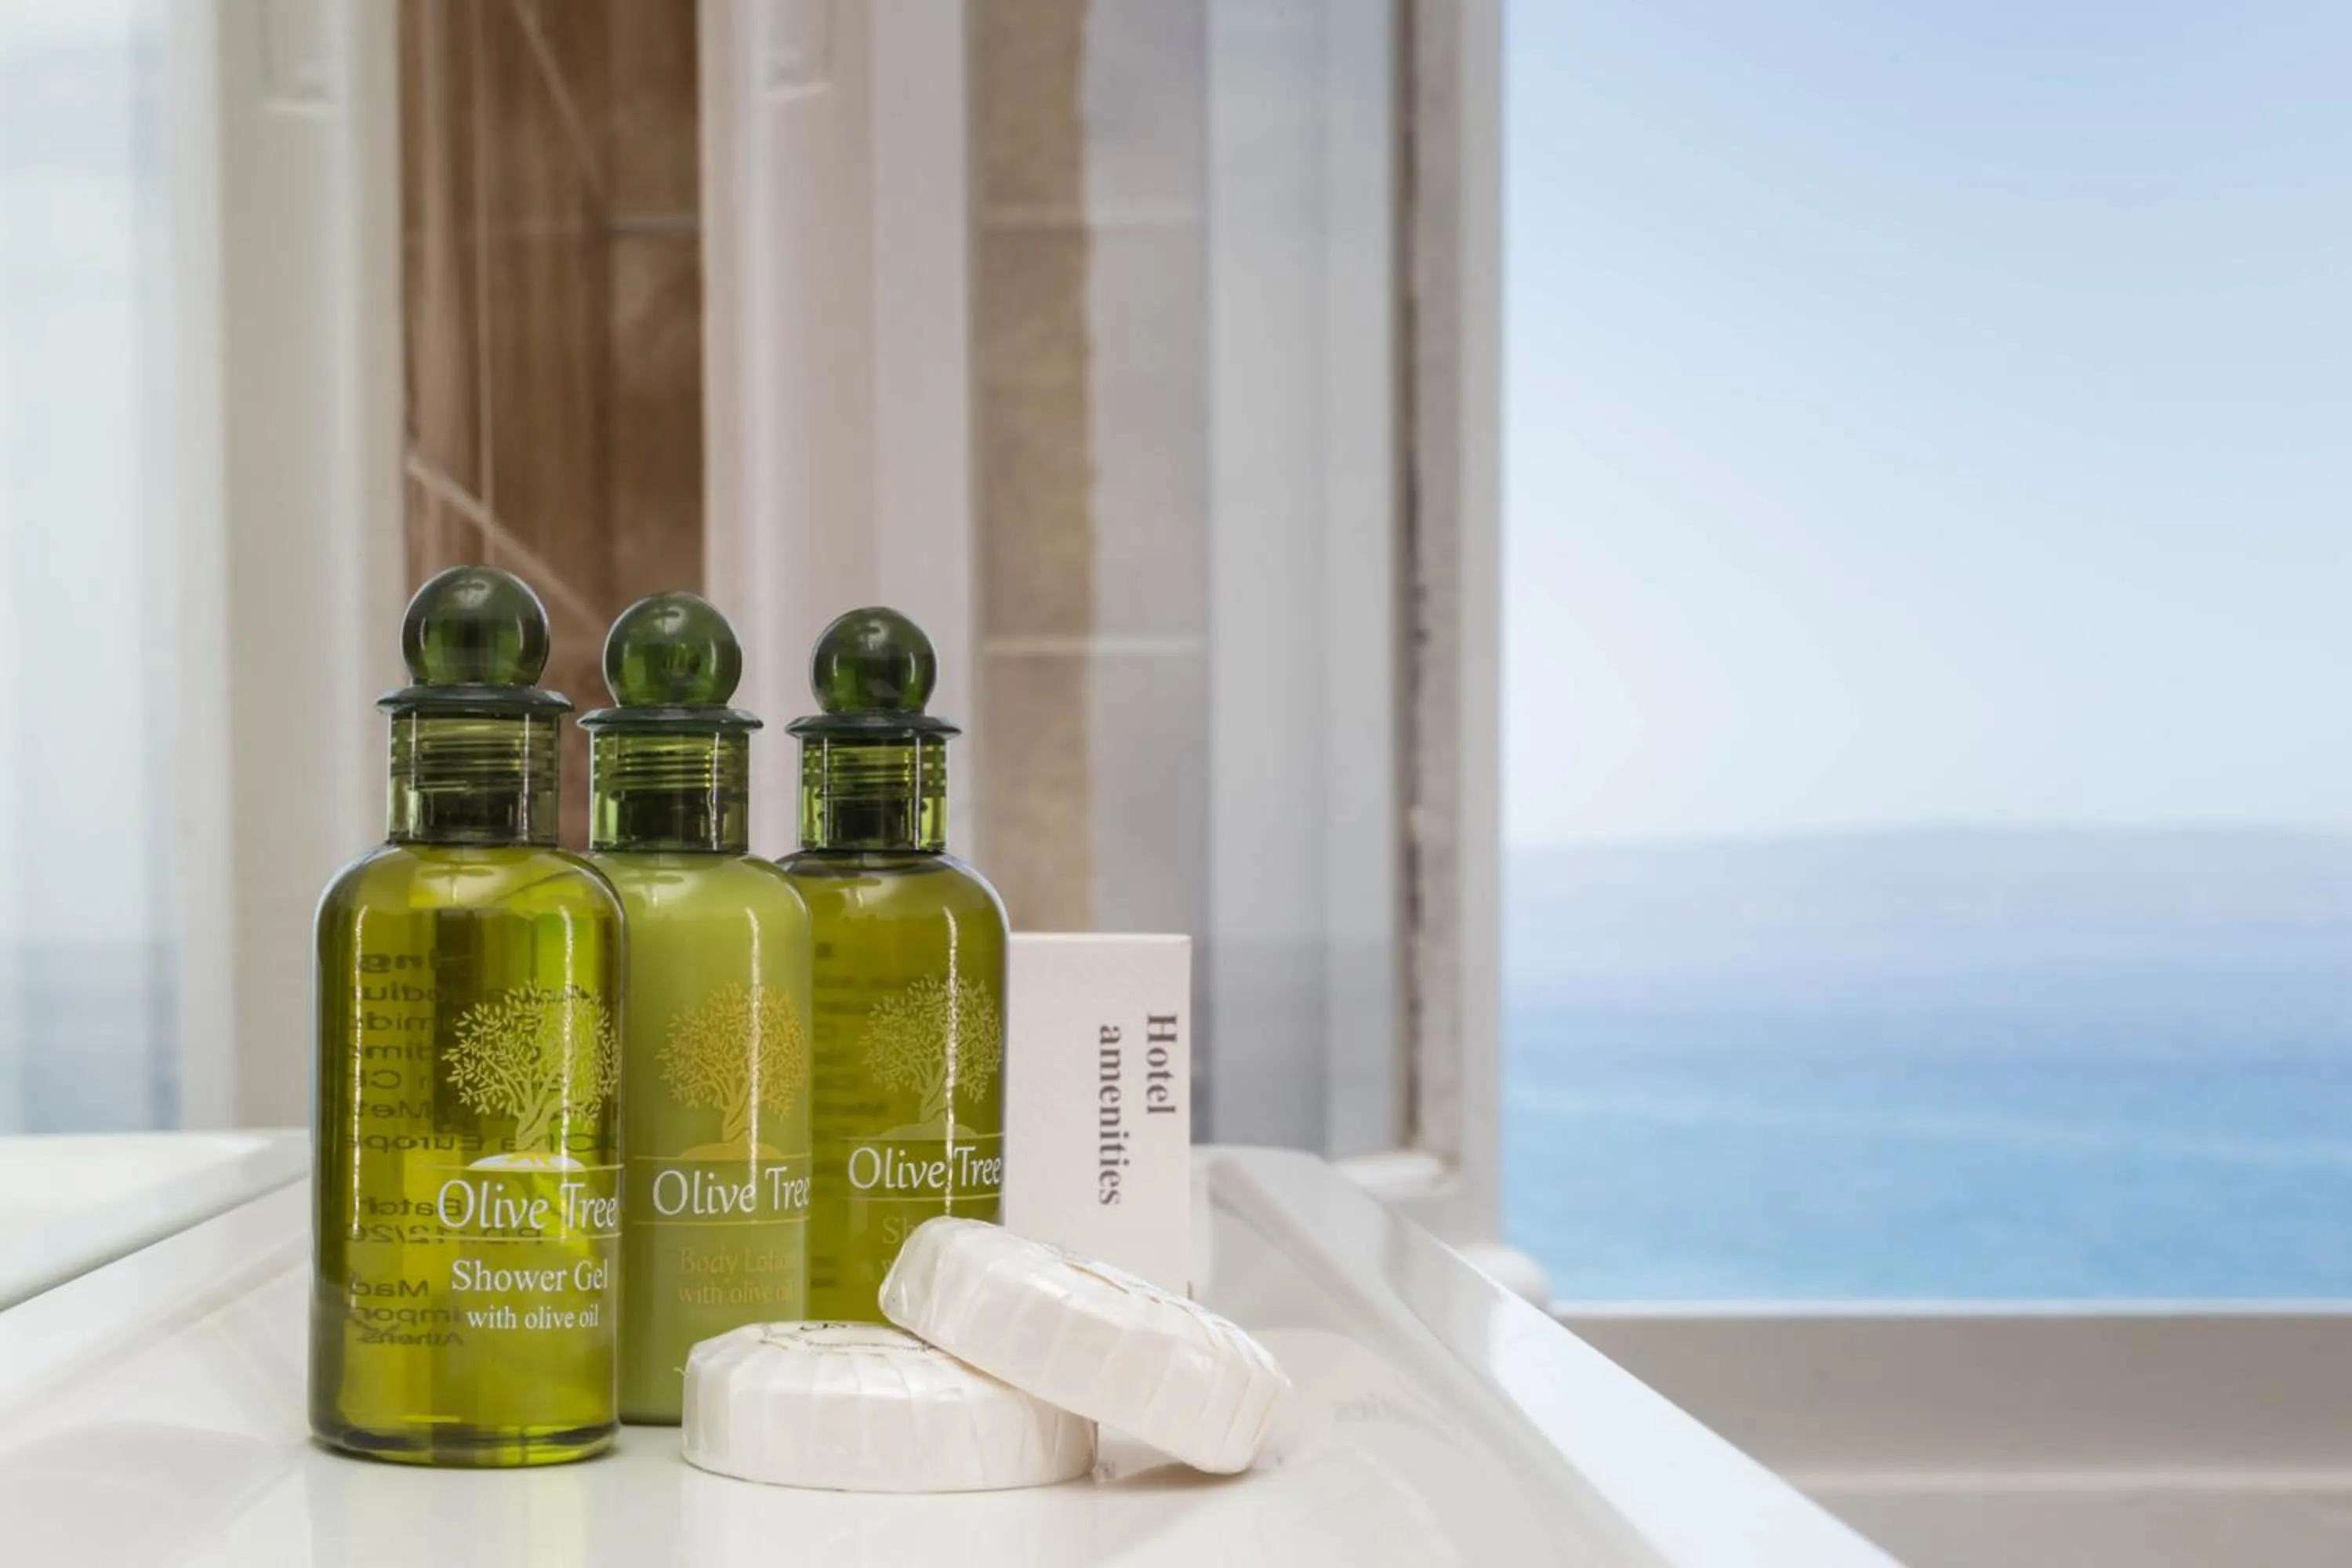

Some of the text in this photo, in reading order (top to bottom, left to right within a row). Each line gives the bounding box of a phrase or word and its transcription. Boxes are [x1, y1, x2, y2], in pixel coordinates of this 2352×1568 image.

[1146, 1014, 1178, 1114] Hotel
[1098, 1024, 1130, 1206] amenities
[848, 1145, 1001, 1190] Olive Tree
[437, 1179, 616, 1229] Olive Tree
[652, 1166, 810, 1215] Olive Tree
[451, 1259, 608, 1293] Shower Gel
[681, 1243, 738, 1276] Body
[678, 1279, 724, 1305] with
[730, 1279, 774, 1304] olive
[466, 1303, 600, 1330] with olive oil
